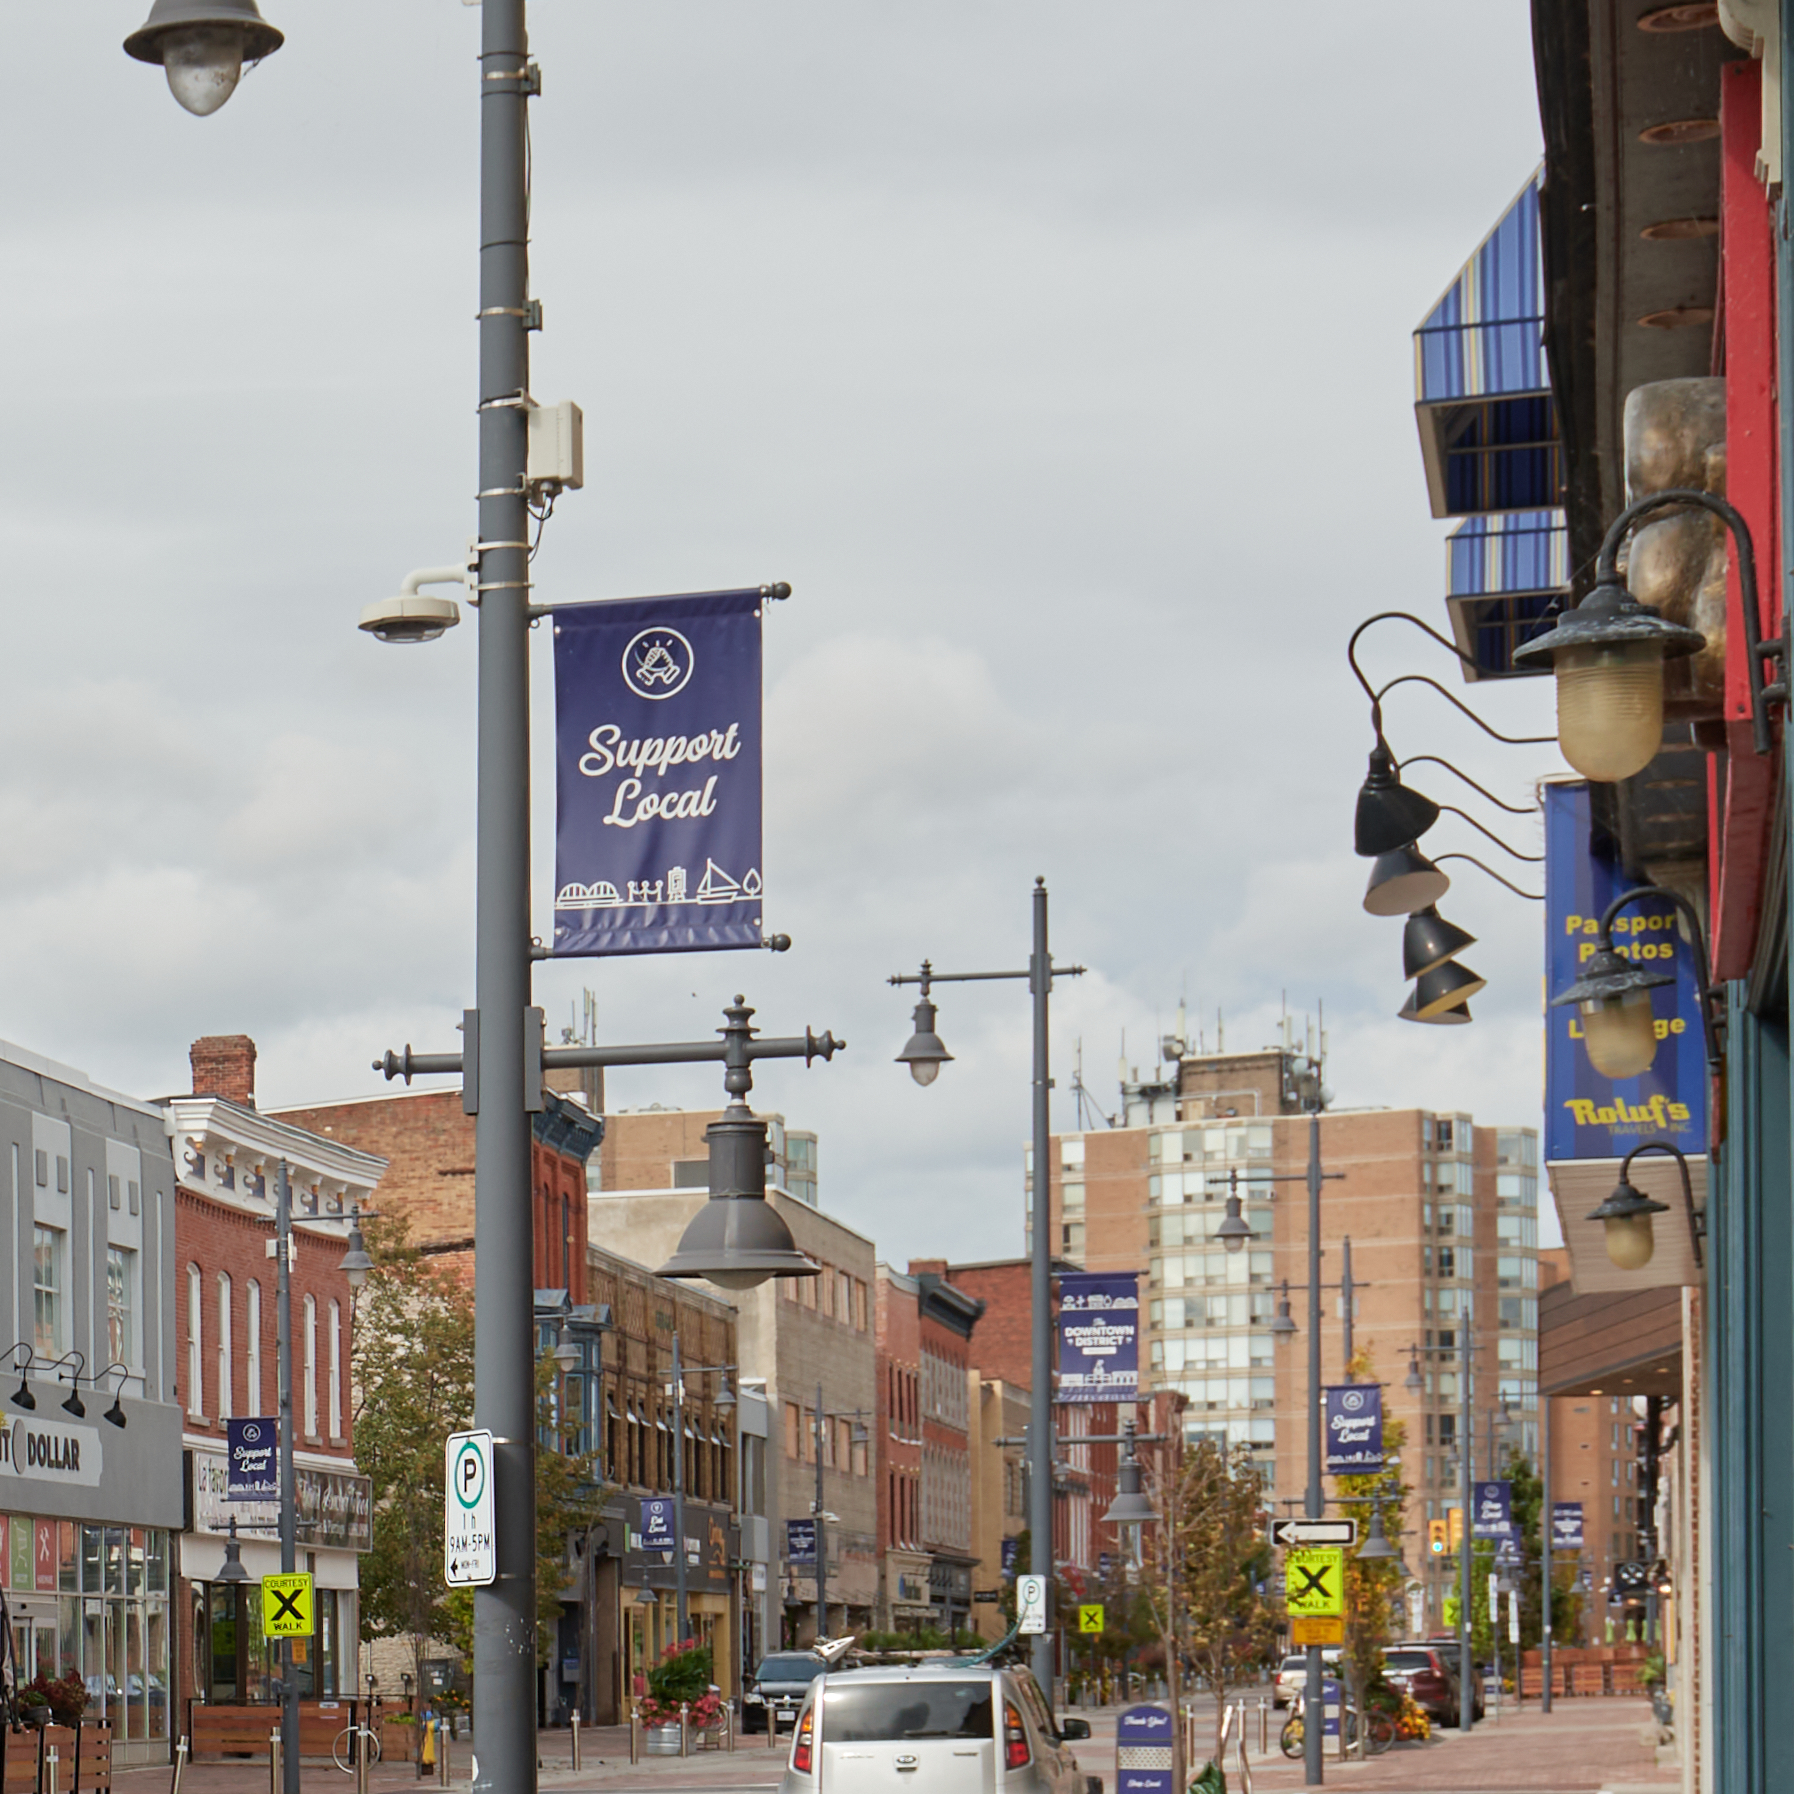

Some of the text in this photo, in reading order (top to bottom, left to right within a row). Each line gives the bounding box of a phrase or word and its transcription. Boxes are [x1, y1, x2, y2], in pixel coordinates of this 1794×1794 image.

[579, 723, 742, 777] Support
[603, 775, 719, 827] Local
[1579, 943, 1674, 963] Potos
[1563, 1094, 1691, 1128] Roluf's
[1607, 1123, 1657, 1136] TRAVELS
[1064, 1325, 1135, 1338] DOWNTOWN
[1074, 1336, 1125, 1347] DISTRICT
[1337, 1428, 1370, 1443] Local
[26, 1432, 80, 1471] DOLLAR
[239, 1459, 268, 1473] Local
[463, 1458, 477, 1493] P
[450, 1533, 491, 1553] 9AM-5PM
[264, 1579, 308, 1589] COURTESY
[273, 1622, 303, 1631] WALK
